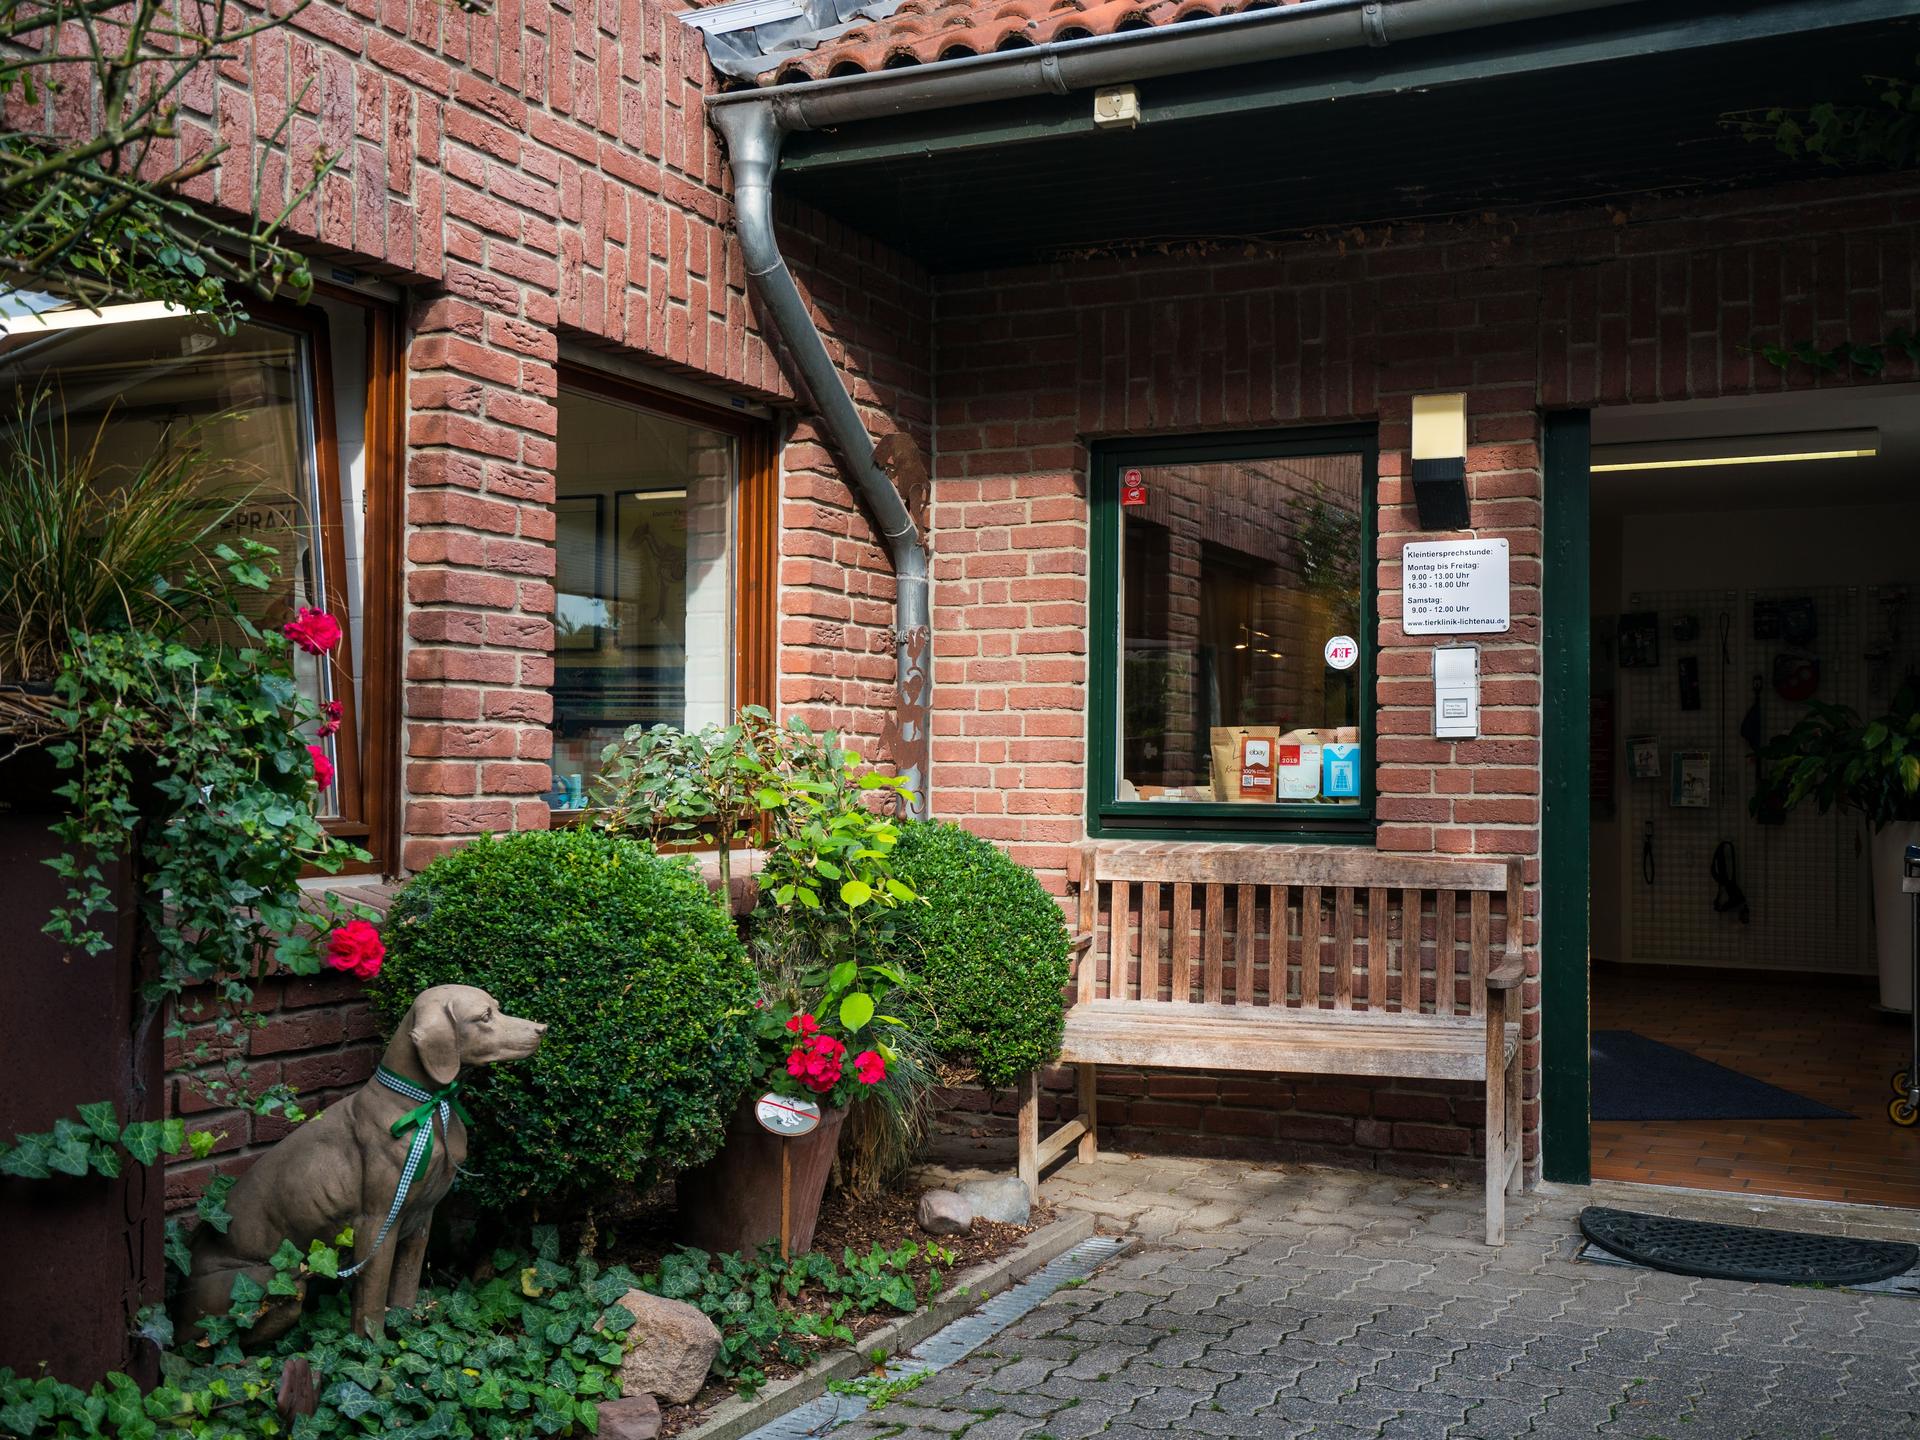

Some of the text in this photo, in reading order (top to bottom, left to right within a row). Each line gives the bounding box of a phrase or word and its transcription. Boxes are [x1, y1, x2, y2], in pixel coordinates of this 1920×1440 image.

[1407, 549, 1493, 558] Kleintiersprechstunde:
[1450, 562, 1480, 570] Freitag:
[1407, 618, 1505, 627] www.tierklinik-lichtenau.de
